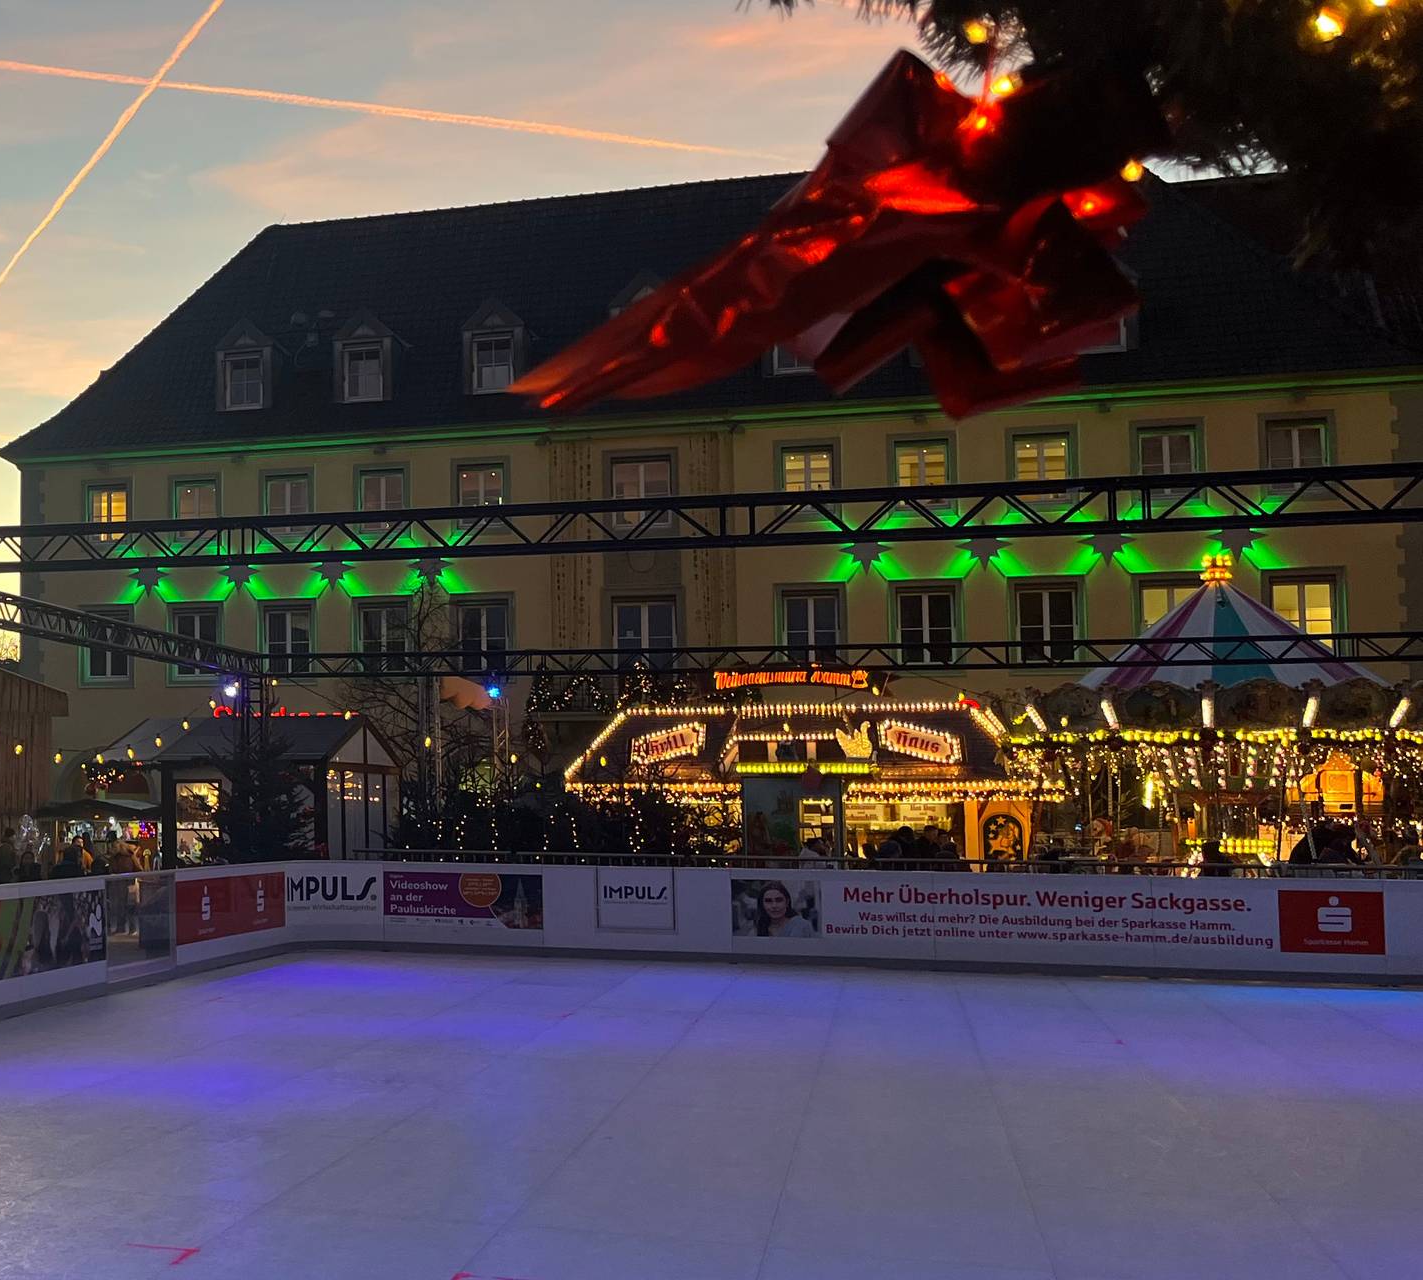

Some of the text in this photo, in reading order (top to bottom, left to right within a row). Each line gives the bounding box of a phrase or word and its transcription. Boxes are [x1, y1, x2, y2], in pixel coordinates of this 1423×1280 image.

[389, 879, 449, 891] Videoshow
[390, 893, 424, 902] an der
[843, 884, 1252, 914] Mehr Überholspur. Weniger Sackgasse.
[390, 904, 457, 915] Pauluskirche
[858, 911, 1236, 931] Was willst du mehr? Die Ausbildung bei der Sparkasse Hamm.
[825, 923, 1274, 949] Bewirb Dich jetzt online unter www.sparkasse-hamm.de/ausbildung
